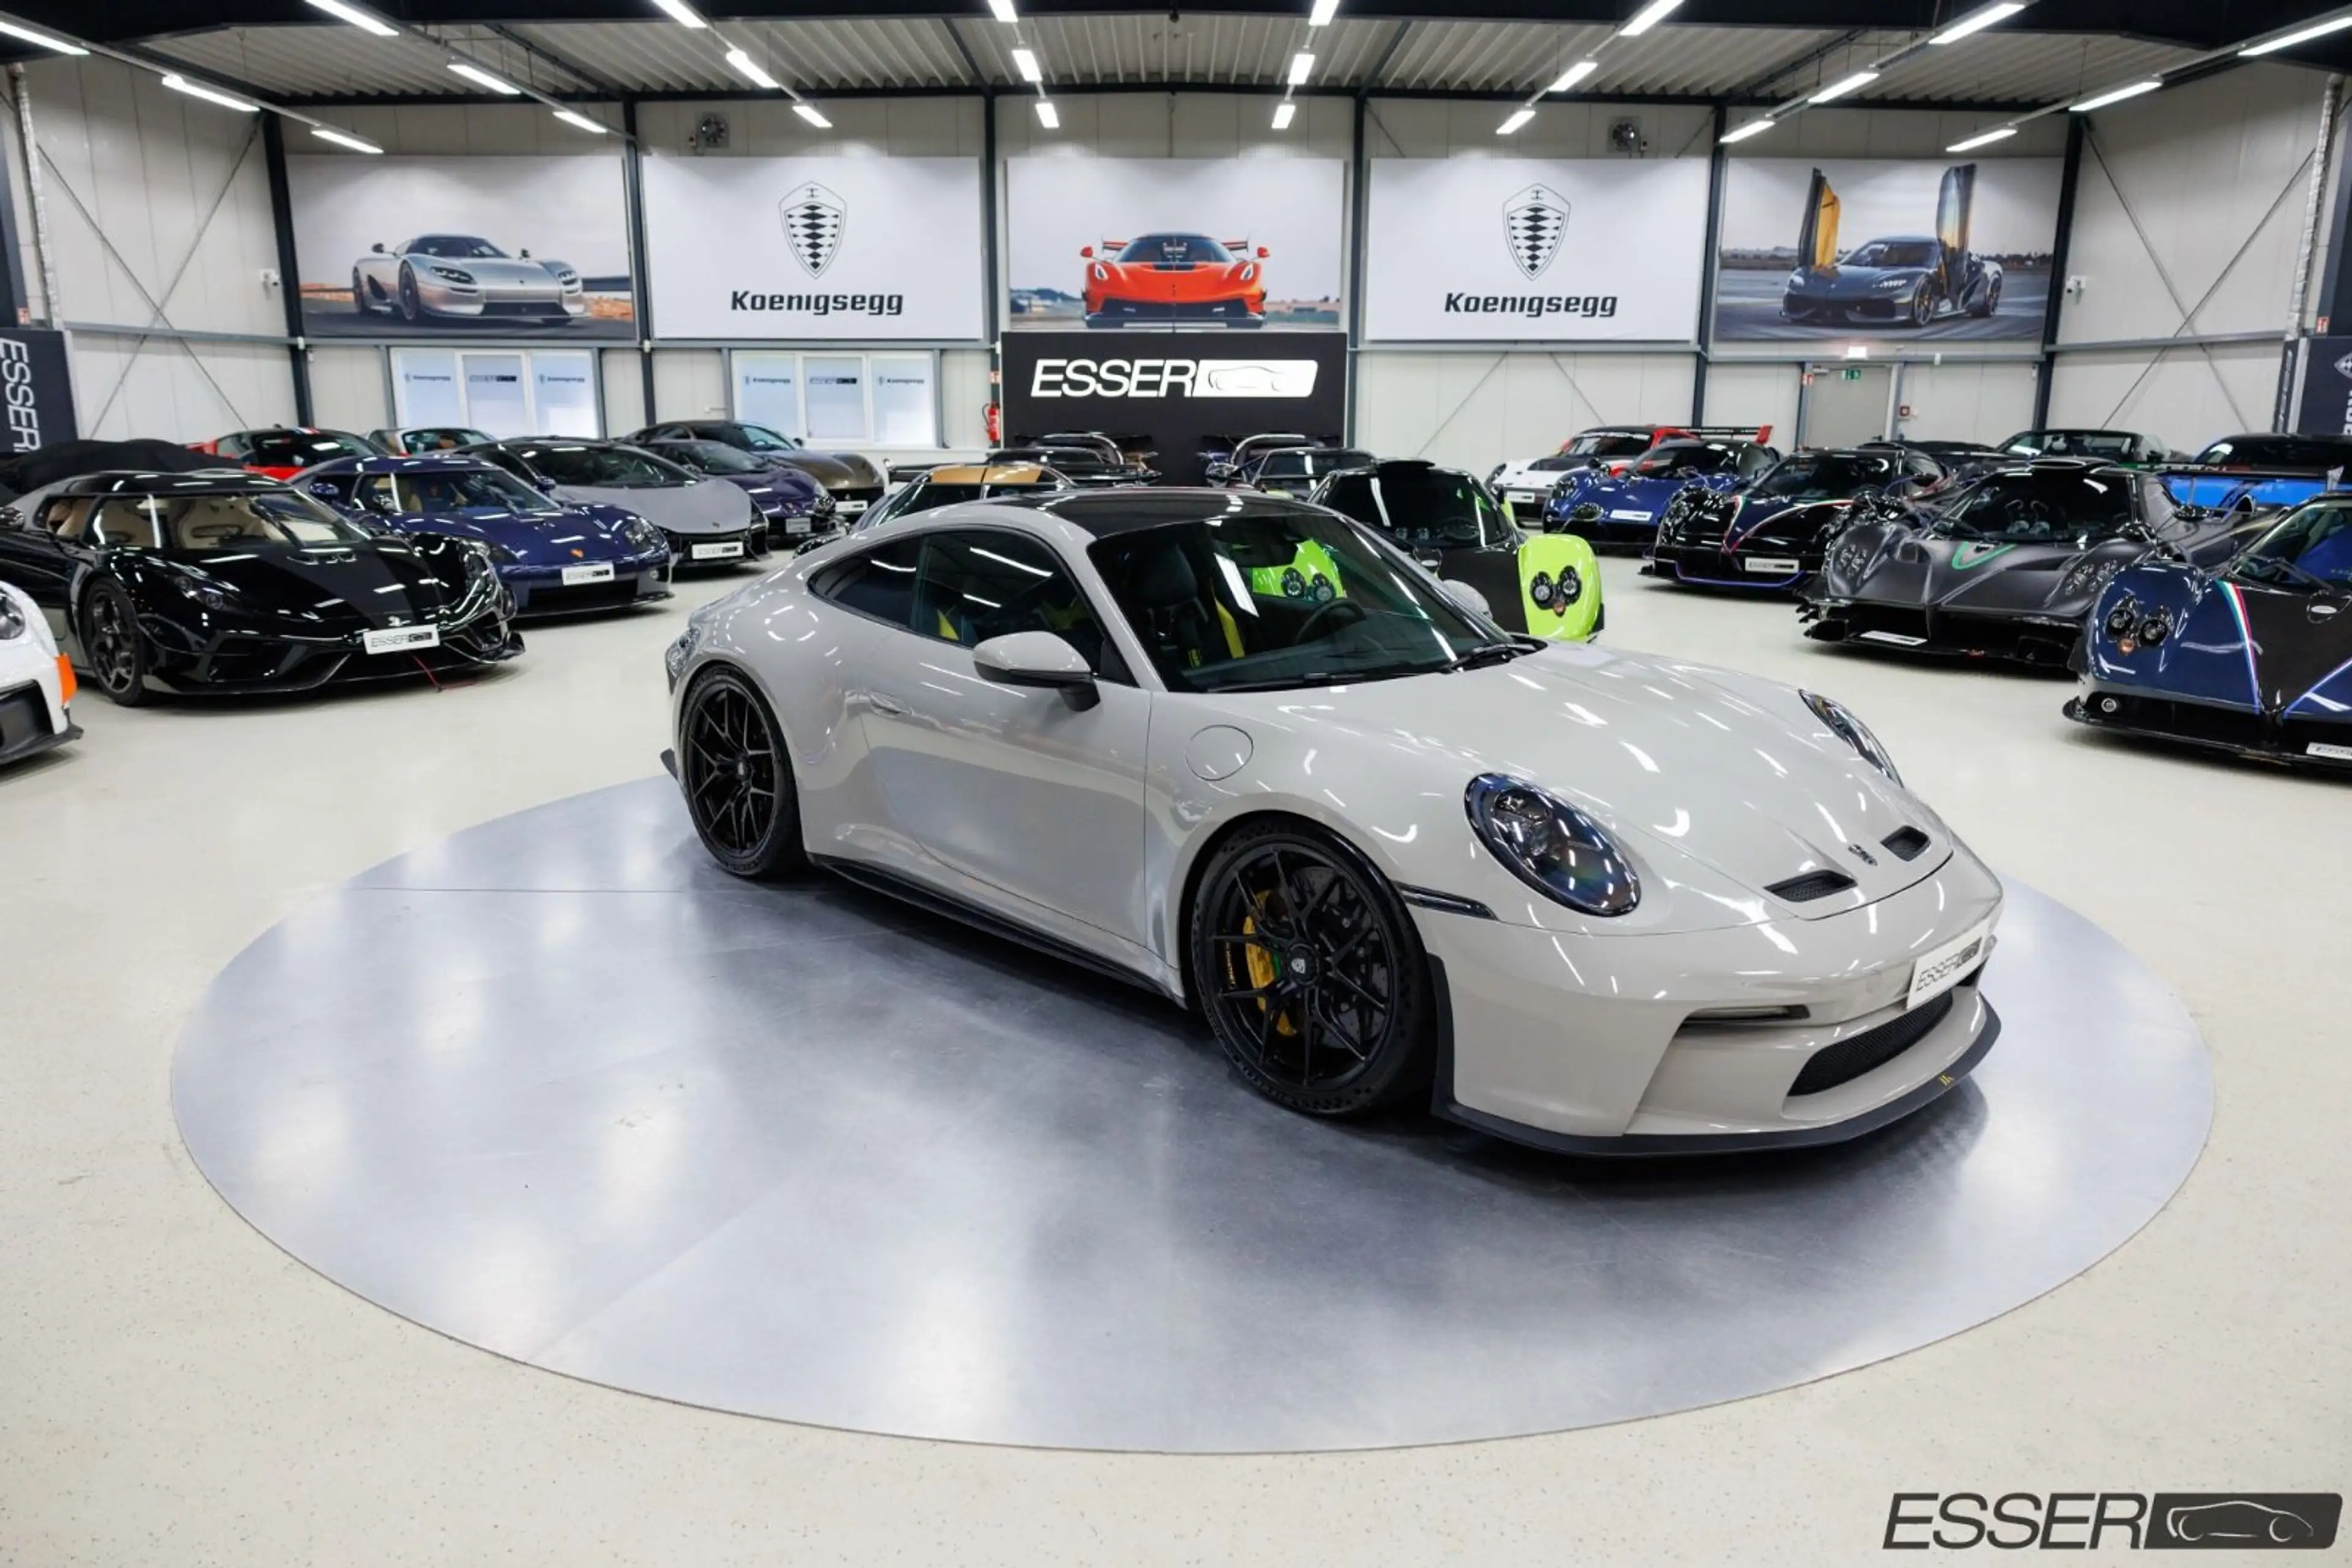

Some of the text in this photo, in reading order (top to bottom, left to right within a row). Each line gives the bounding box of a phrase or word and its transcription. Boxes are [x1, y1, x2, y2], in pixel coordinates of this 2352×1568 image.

[731, 290, 903, 315] Koenigsegg
[1444, 292, 1618, 318] Koenigsegg
[0, 337, 42, 451] ESSER
[1030, 358, 1197, 398] ESSER
[371, 635, 410, 647] ESSER
[1915, 953, 1961, 992] ESSER
